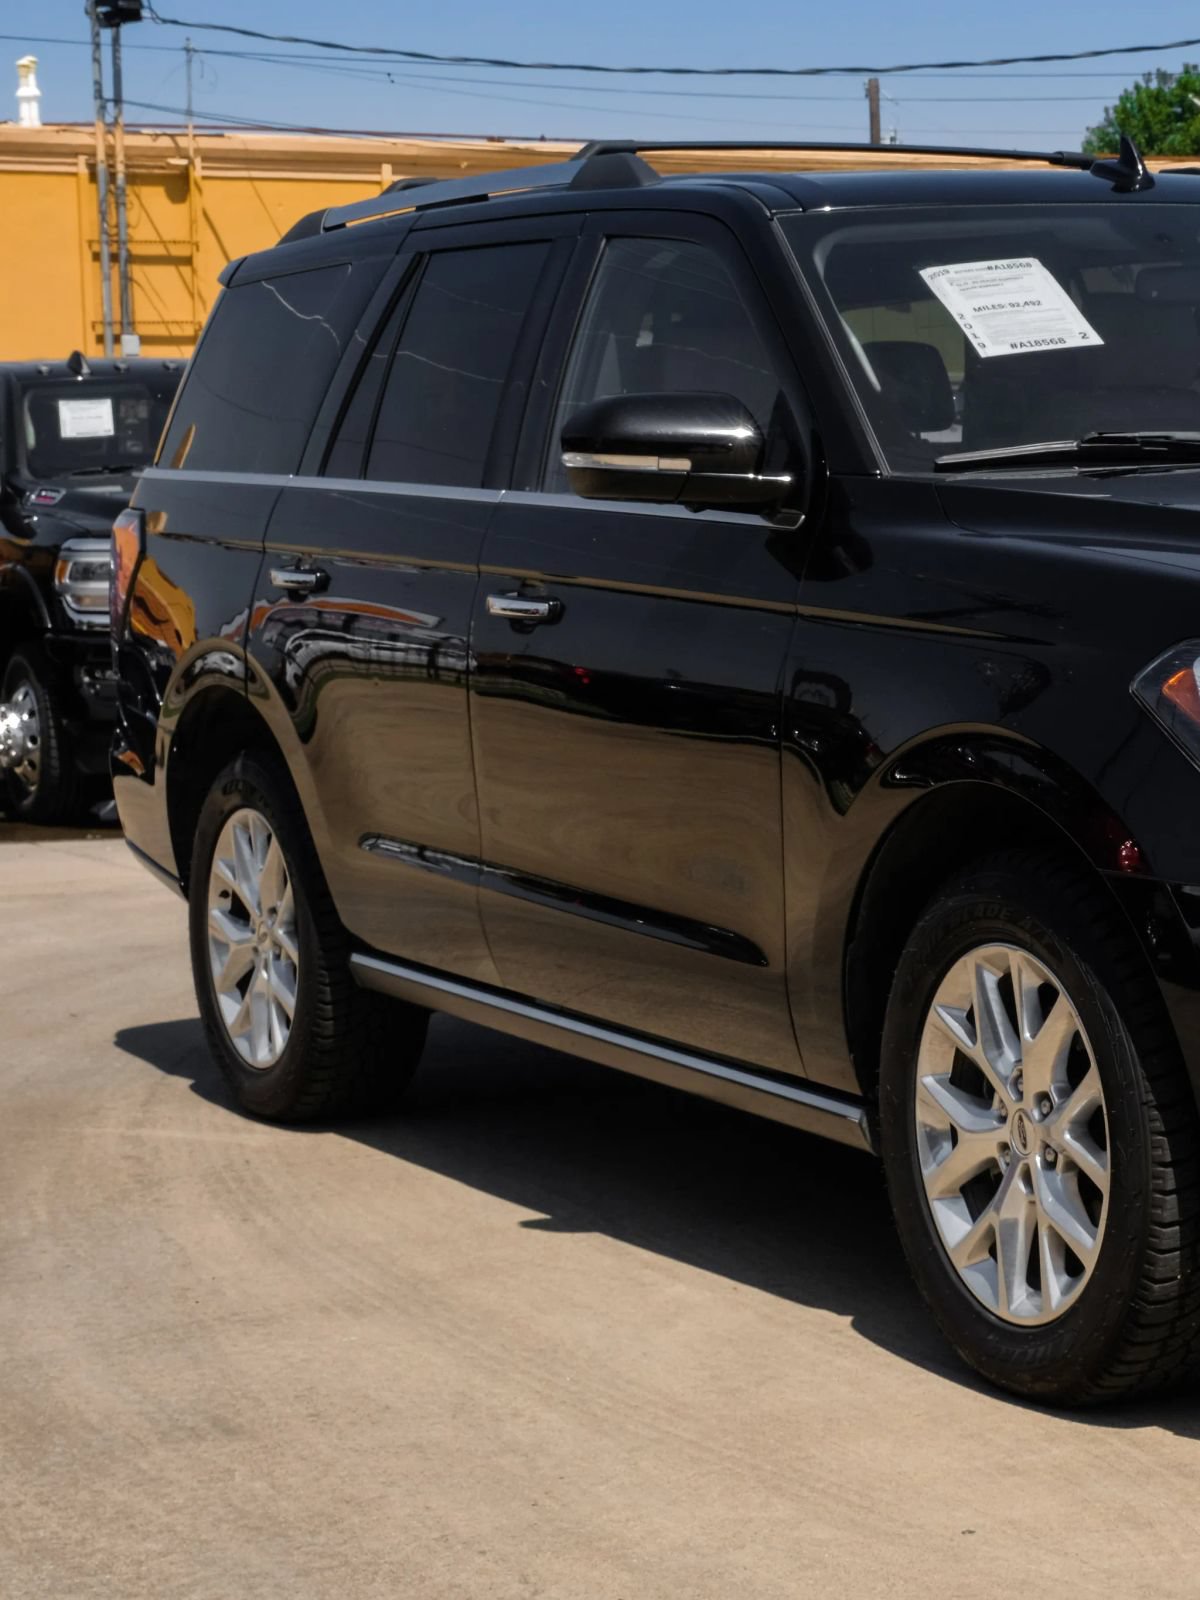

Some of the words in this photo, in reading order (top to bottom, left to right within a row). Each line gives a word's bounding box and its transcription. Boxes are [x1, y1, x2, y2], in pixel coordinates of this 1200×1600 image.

[986, 262, 1032, 271] #A18568
[972, 303, 1006, 313] MILES:
[1008, 300, 1042, 309] 92,492
[1078, 331, 1090, 340] 2
[1010, 337, 1067, 350] #A18568
